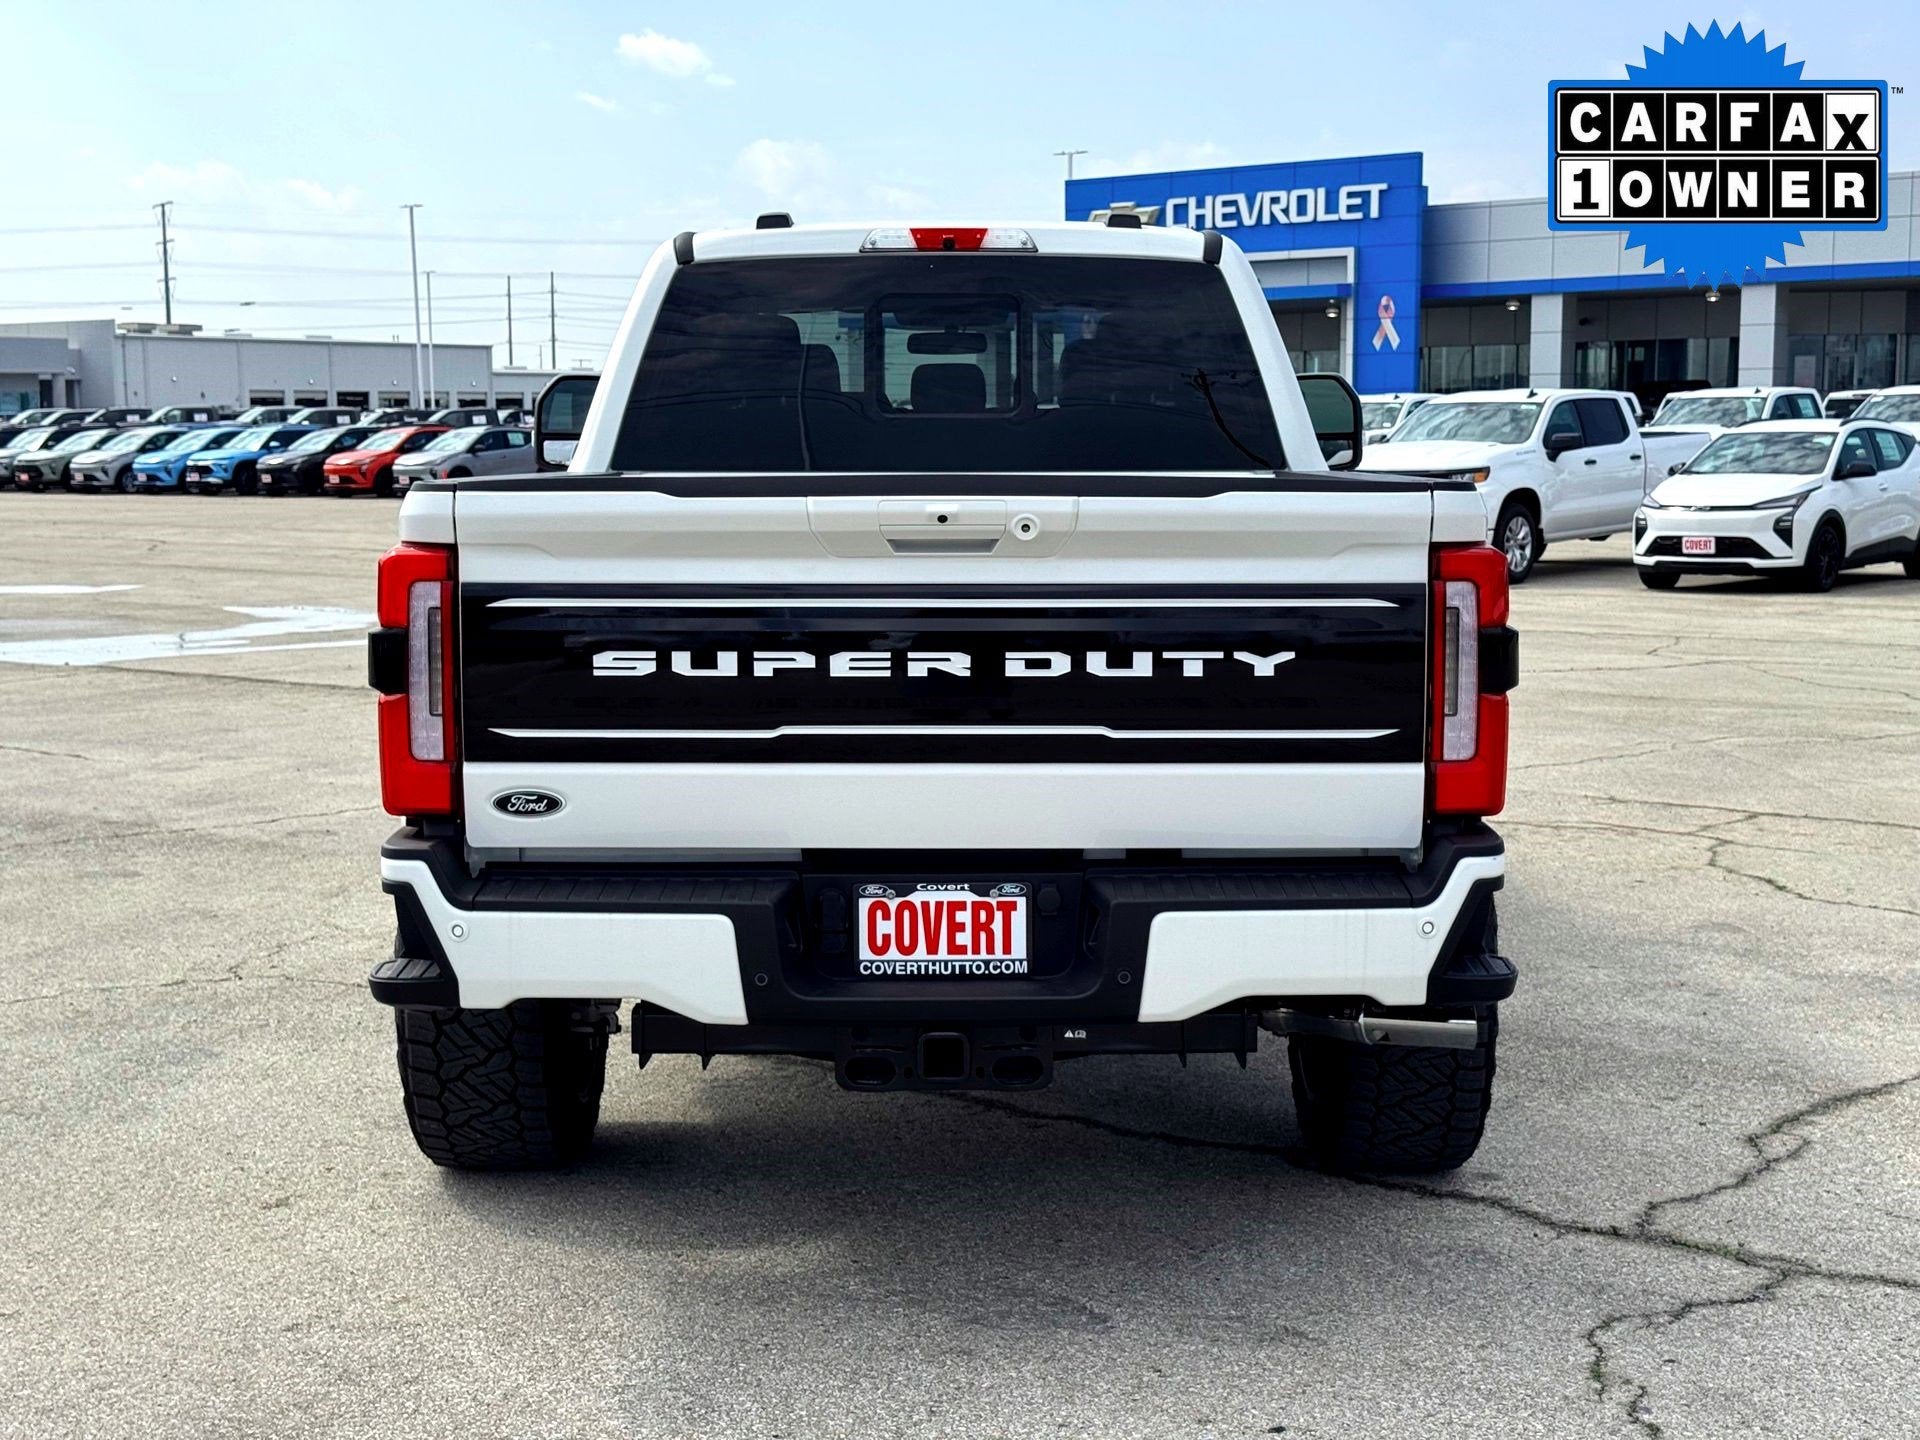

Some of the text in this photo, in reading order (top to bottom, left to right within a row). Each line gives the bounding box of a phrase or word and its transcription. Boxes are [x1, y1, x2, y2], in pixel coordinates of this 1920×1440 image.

[1165, 182, 1389, 229] CHEVROLET
[1684, 539, 1713, 551] COVERT
[592, 650, 1296, 677] SUPER DUTY
[507, 794, 548, 812] Ford
[916, 882, 971, 891] Covert
[867, 900, 1018, 957] COVERT
[859, 961, 1029, 976] COVERTHUTTO.COM
